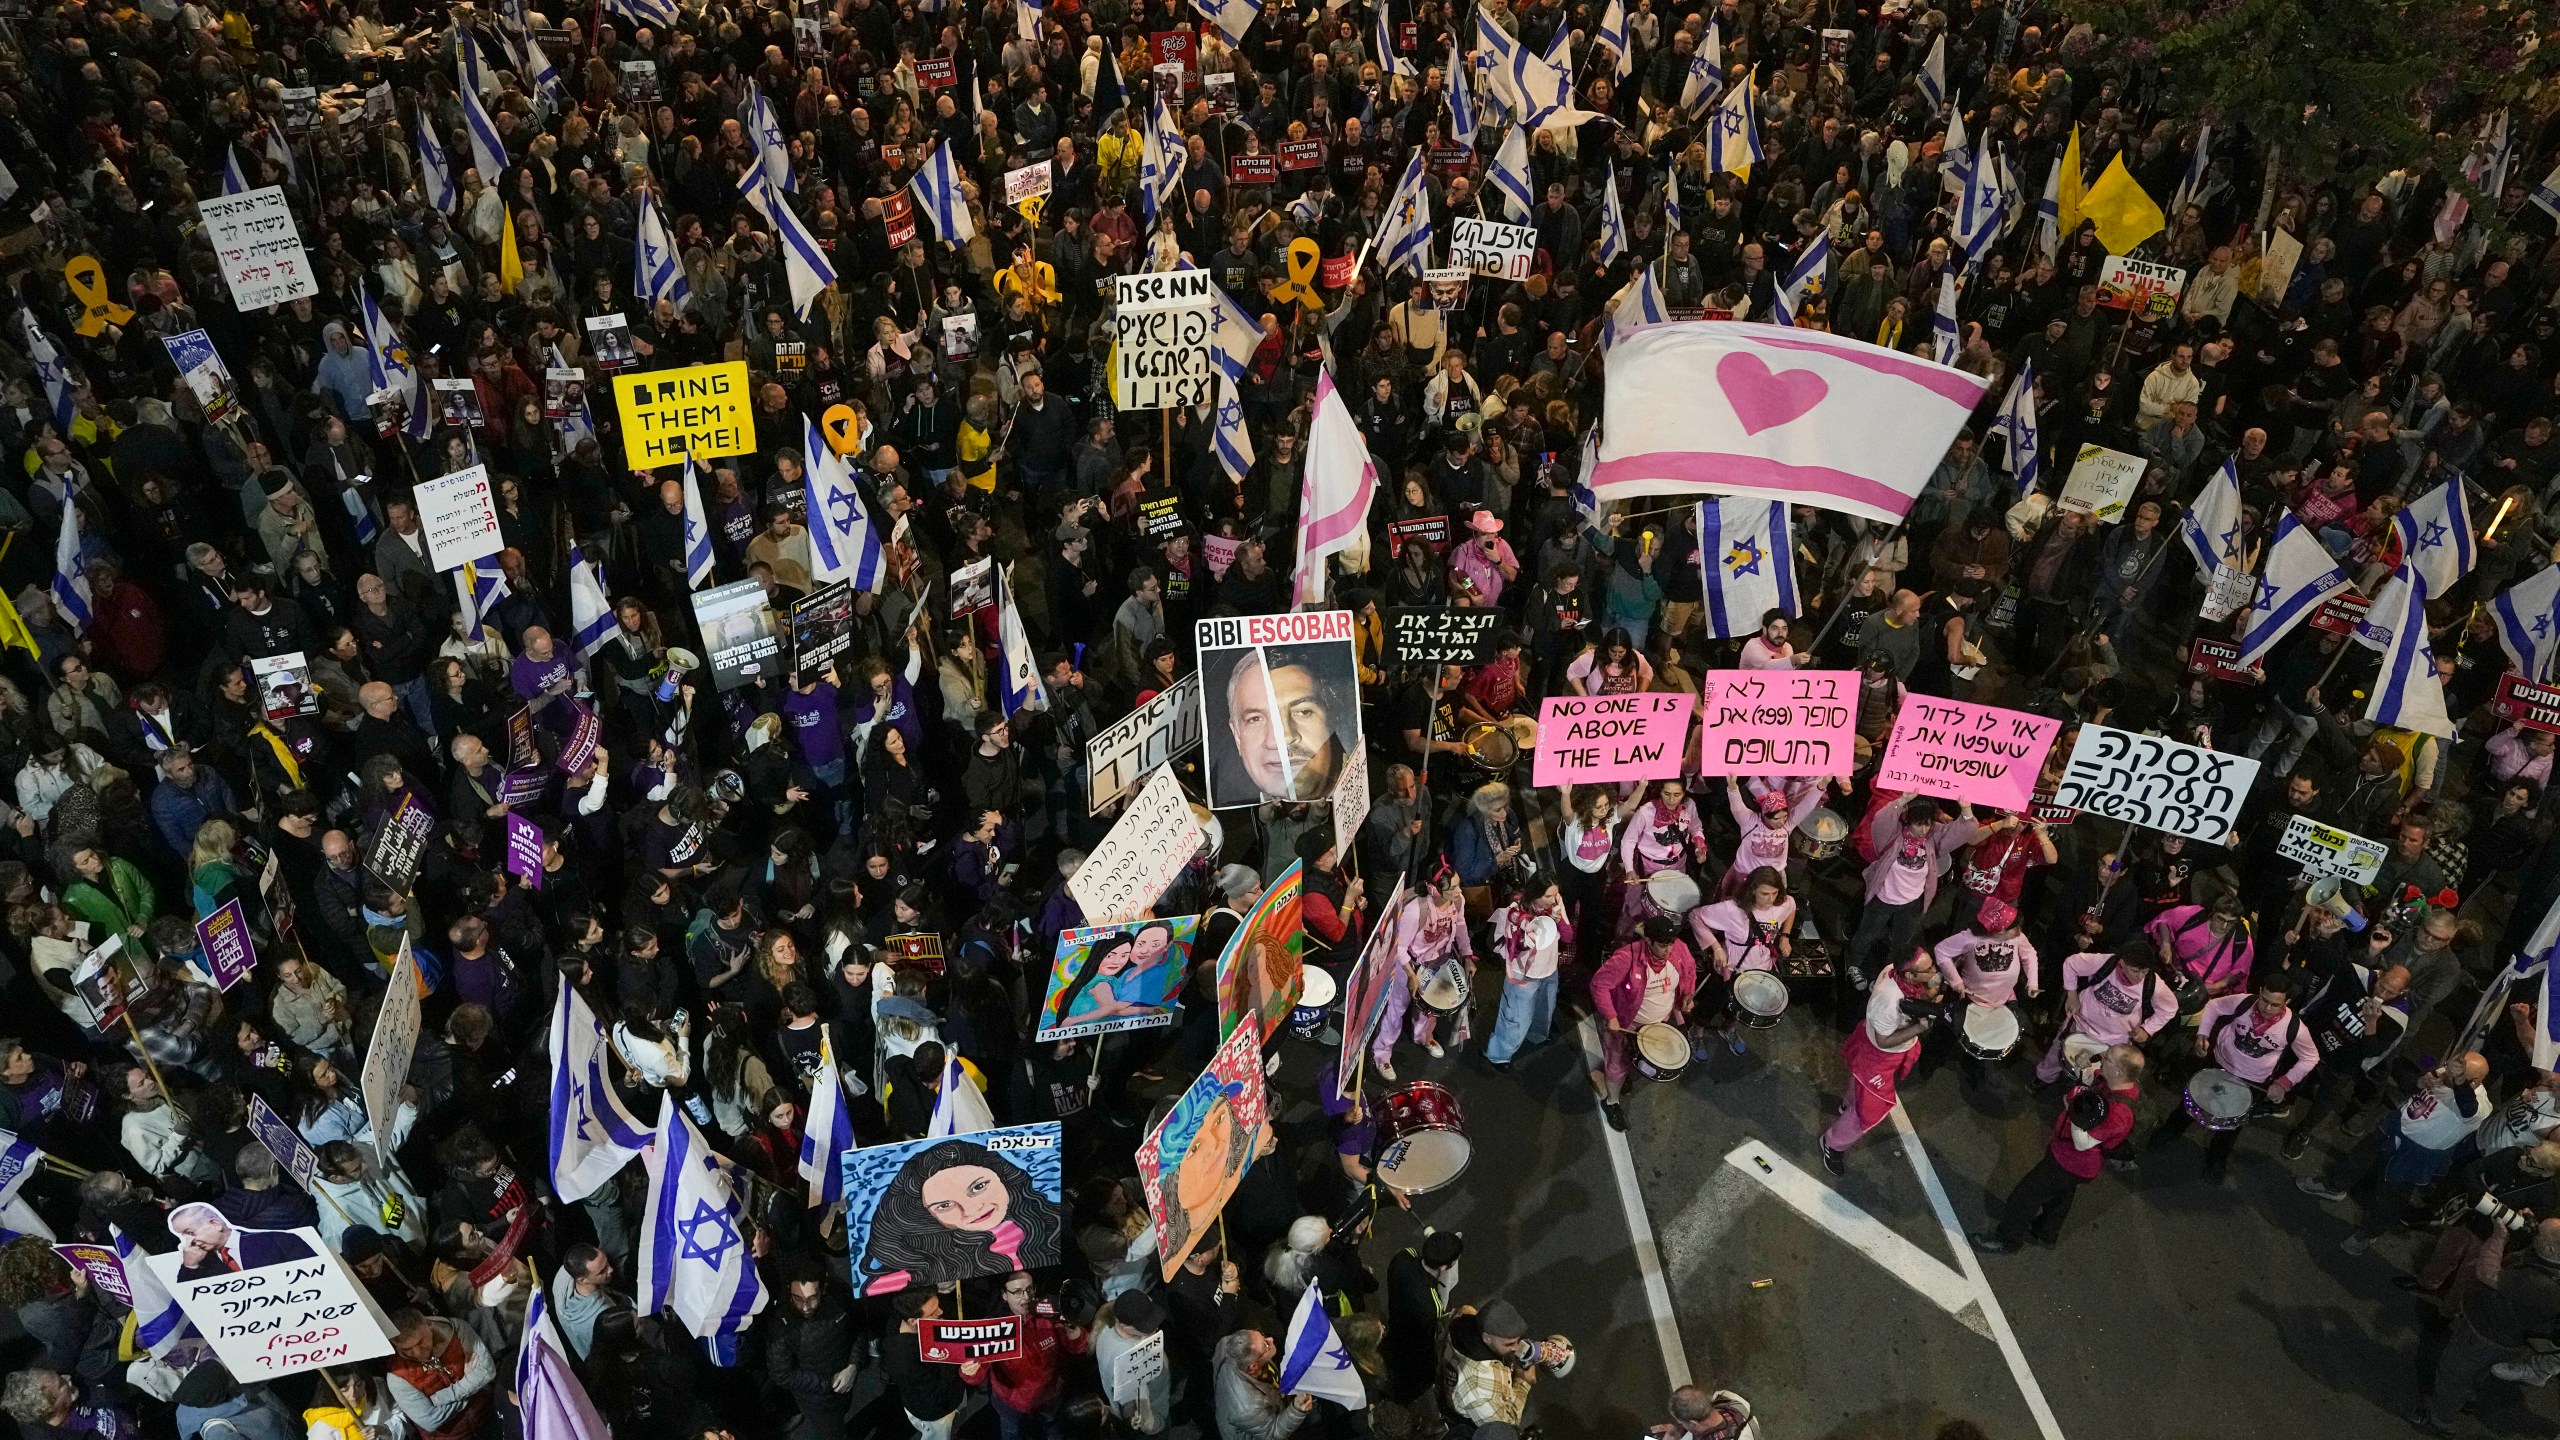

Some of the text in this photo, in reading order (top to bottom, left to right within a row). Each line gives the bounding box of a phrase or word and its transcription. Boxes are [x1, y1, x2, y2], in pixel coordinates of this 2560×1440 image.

[929, 70, 951, 79] עכשיו
[939, 62, 950, 70] את
[1296, 151, 1318, 159] עכשיו
[1343, 157, 1364, 166] FCK
[1509, 254, 1531, 280] תן
[1290, 282, 1308, 294] NOW.
[91, 304, 112, 318] NOW.
[634, 374, 729, 406] BRING
[1450, 398, 1471, 411] FCK
[440, 470, 478, 488] החטופים
[1149, 506, 1174, 518] חטופים
[1160, 496, 1178, 507] אנחנו
[1392, 524, 1425, 534] המכשולם
[1205, 544, 1233, 557] HOSTA
[2217, 565, 2252, 587] LIVES
[2212, 580, 2248, 601] not lies
[1395, 614, 1497, 630] תציל את
[2201, 606, 2215, 616] not
[2324, 608, 2350, 621] CALLING
[1199, 612, 1352, 648] BIBI ESCOBAR
[1399, 630, 1479, 645] המדינה
[713, 635, 776, 662] אחרת המלחמה
[716, 647, 778, 670] תגמור את כולנו
[800, 632, 850, 663] אחרת המלחמה
[801, 640, 851, 671] תגמור את כולנו
[1396, 646, 1476, 661] מעצמך
[1725, 676, 1766, 699] לא
[2512, 683, 2560, 707] חופש
[1551, 697, 1679, 718] NO ONE IS
[1710, 705, 1848, 729] סופר את
[1916, 703, 1997, 733] לו לדור
[1130, 697, 1166, 741] את
[1565, 718, 1648, 741] ABOVE
[1724, 737, 1831, 766] החטופים
[1907, 726, 2031, 760] ששפטו את
[1553, 742, 1665, 769] THE LAW
[2096, 730, 2234, 784] עסקה
[1886, 769, 1908, 782] רבה
[2108, 766, 2234, 813] חלקית
[2038, 807, 2071, 818] נולדו
[2160, 804, 2230, 840] רצח
[374, 818, 399, 862] די למלחמה
[511, 831, 541, 854] למלחמת
[518, 822, 535, 841] לא
[405, 840, 424, 861] WAR
[2277, 843, 2326, 867] אמונים
[2287, 833, 2338, 860] רמאי
[391, 847, 411, 870] STOP
[400, 859, 416, 877] THE
[518, 852, 536, 868] בעזה
[221, 949, 244, 973] חיים
[1135, 1015, 1169, 1030] החזירו
[2325, 1030, 2342, 1048] FCK
[990, 1137, 1053, 1151] דניאלה
[1387, 1140, 1412, 1172] Legend
[192, 1264, 327, 1301] מתי בפעם
[220, 1289, 322, 1318] האחרונה
[218, 1302, 358, 1340] עשית משהו
[940, 1321, 1014, 1340] לחופש
[267, 1327, 340, 1351] בשביל
[971, 1340, 1015, 1358] נולדו
[1129, 1336, 1161, 1361] אחרת
